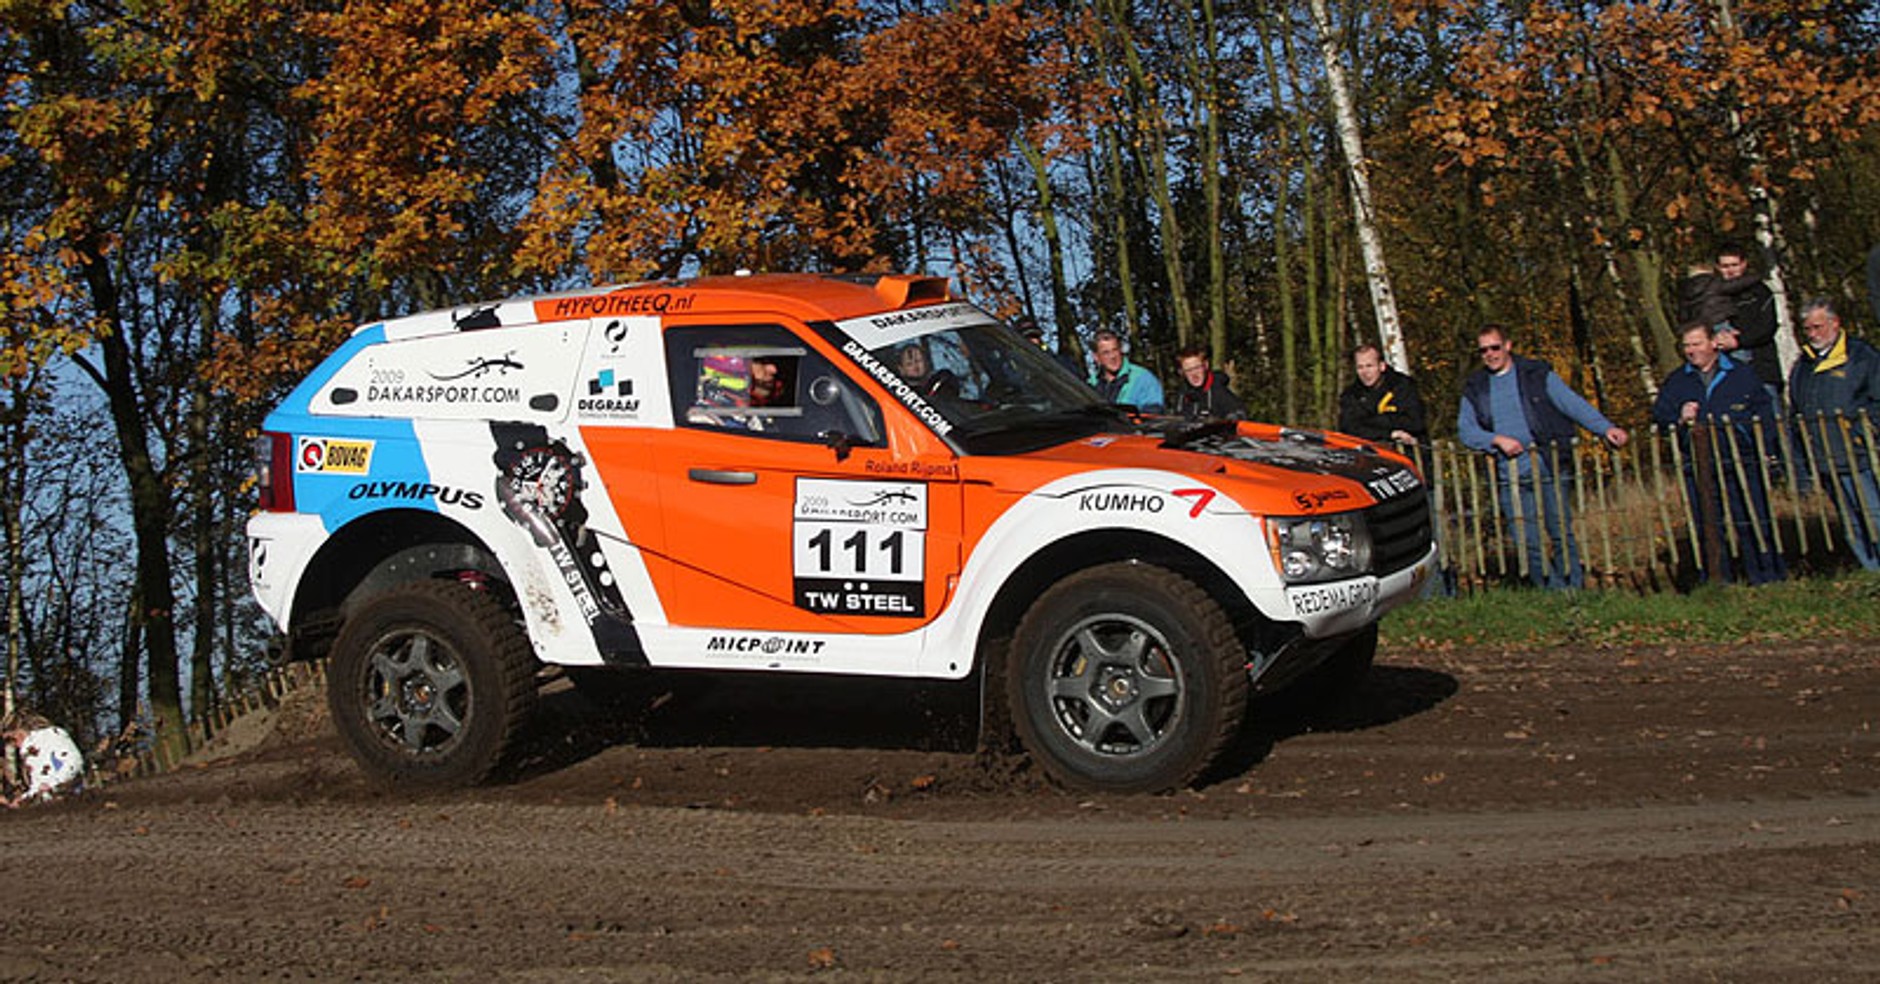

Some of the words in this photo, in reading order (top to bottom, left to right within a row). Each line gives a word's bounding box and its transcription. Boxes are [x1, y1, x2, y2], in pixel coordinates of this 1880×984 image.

[555, 294, 696, 315] HYPOTHEEQ.nl
[371, 369, 404, 384] 2009
[367, 385, 520, 403] DAKARSPORT.COM
[843, 341, 952, 436] DAKARSPORT.COM
[326, 446, 368, 468] BOVAG
[349, 481, 485, 510] OLYMPUS
[1079, 493, 1165, 513] KUMHO
[808, 528, 904, 575] 111
[805, 592, 840, 608] TW
[846, 594, 915, 612] STEEL
